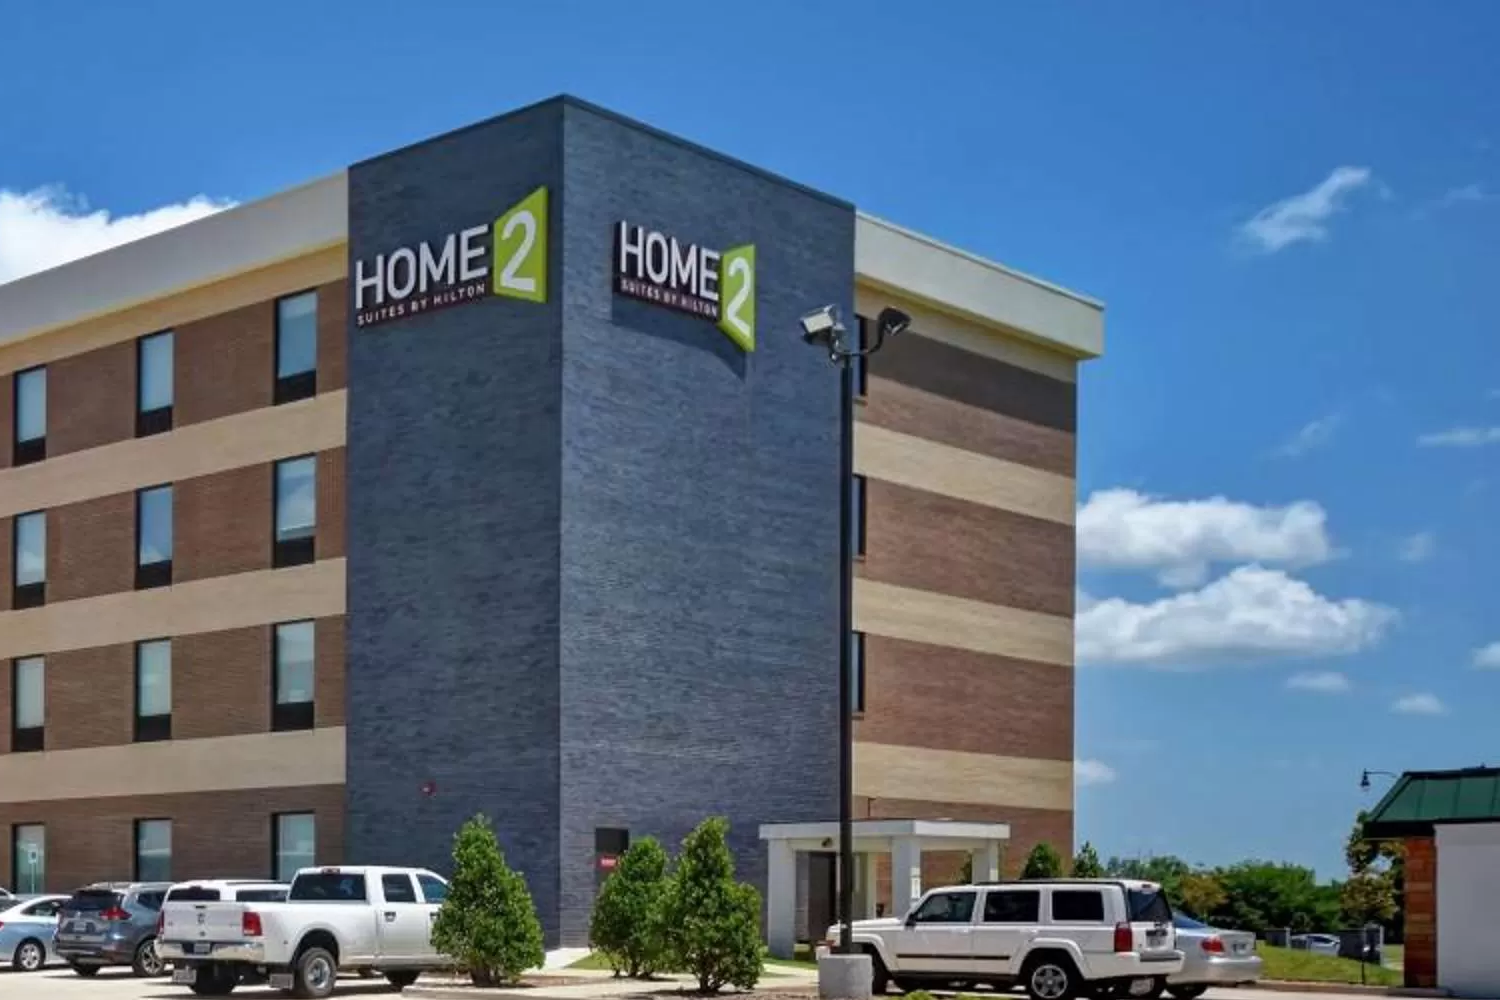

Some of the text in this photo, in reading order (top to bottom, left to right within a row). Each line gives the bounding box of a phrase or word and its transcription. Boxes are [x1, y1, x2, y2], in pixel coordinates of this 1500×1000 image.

[355, 210, 537, 309] HOME 2
[620, 220, 751, 338] HOME 2
[357, 283, 486, 326] SUITES BY HILTON
[621, 278, 718, 317] SUITES BY HILTON
